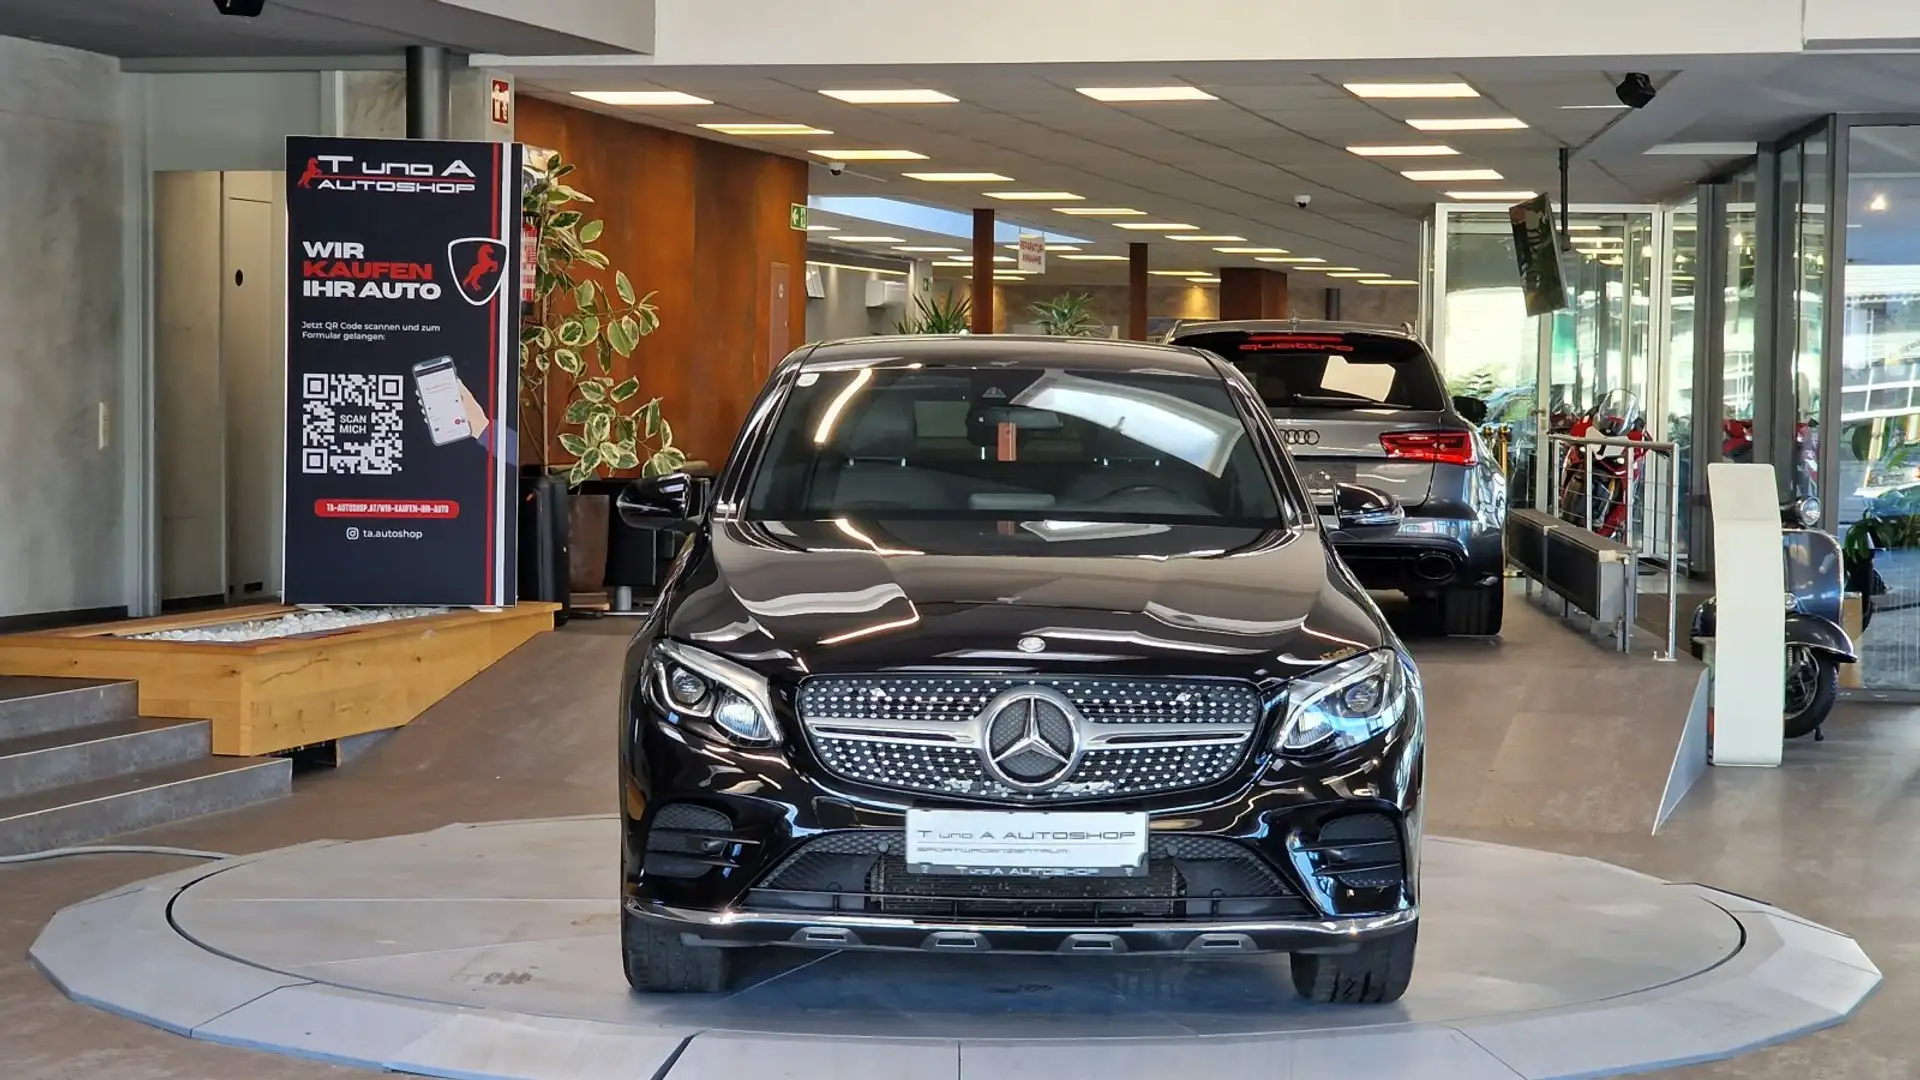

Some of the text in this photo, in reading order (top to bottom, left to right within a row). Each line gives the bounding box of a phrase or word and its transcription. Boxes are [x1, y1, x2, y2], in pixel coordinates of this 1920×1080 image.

[317, 155, 354, 173] T
[441, 159, 476, 178] A
[317, 179, 476, 194] AUTOSHOP
[302, 241, 365, 259] WIR
[303, 261, 433, 280] KAUFEN
[303, 280, 442, 301] IHR AUTO
[301, 321, 441, 332] Jetzt QR Code scannen und zum
[302, 331, 342, 339] Formular
[1239, 343, 1354, 351] quattro
[340, 414, 367, 423] SCAN
[340, 424, 367, 434] MICH
[363, 529, 423, 540] ta.autoshop
[916, 830, 932, 838] T
[980, 831, 995, 839] A
[1003, 831, 1136, 840] AUTOSHOP
